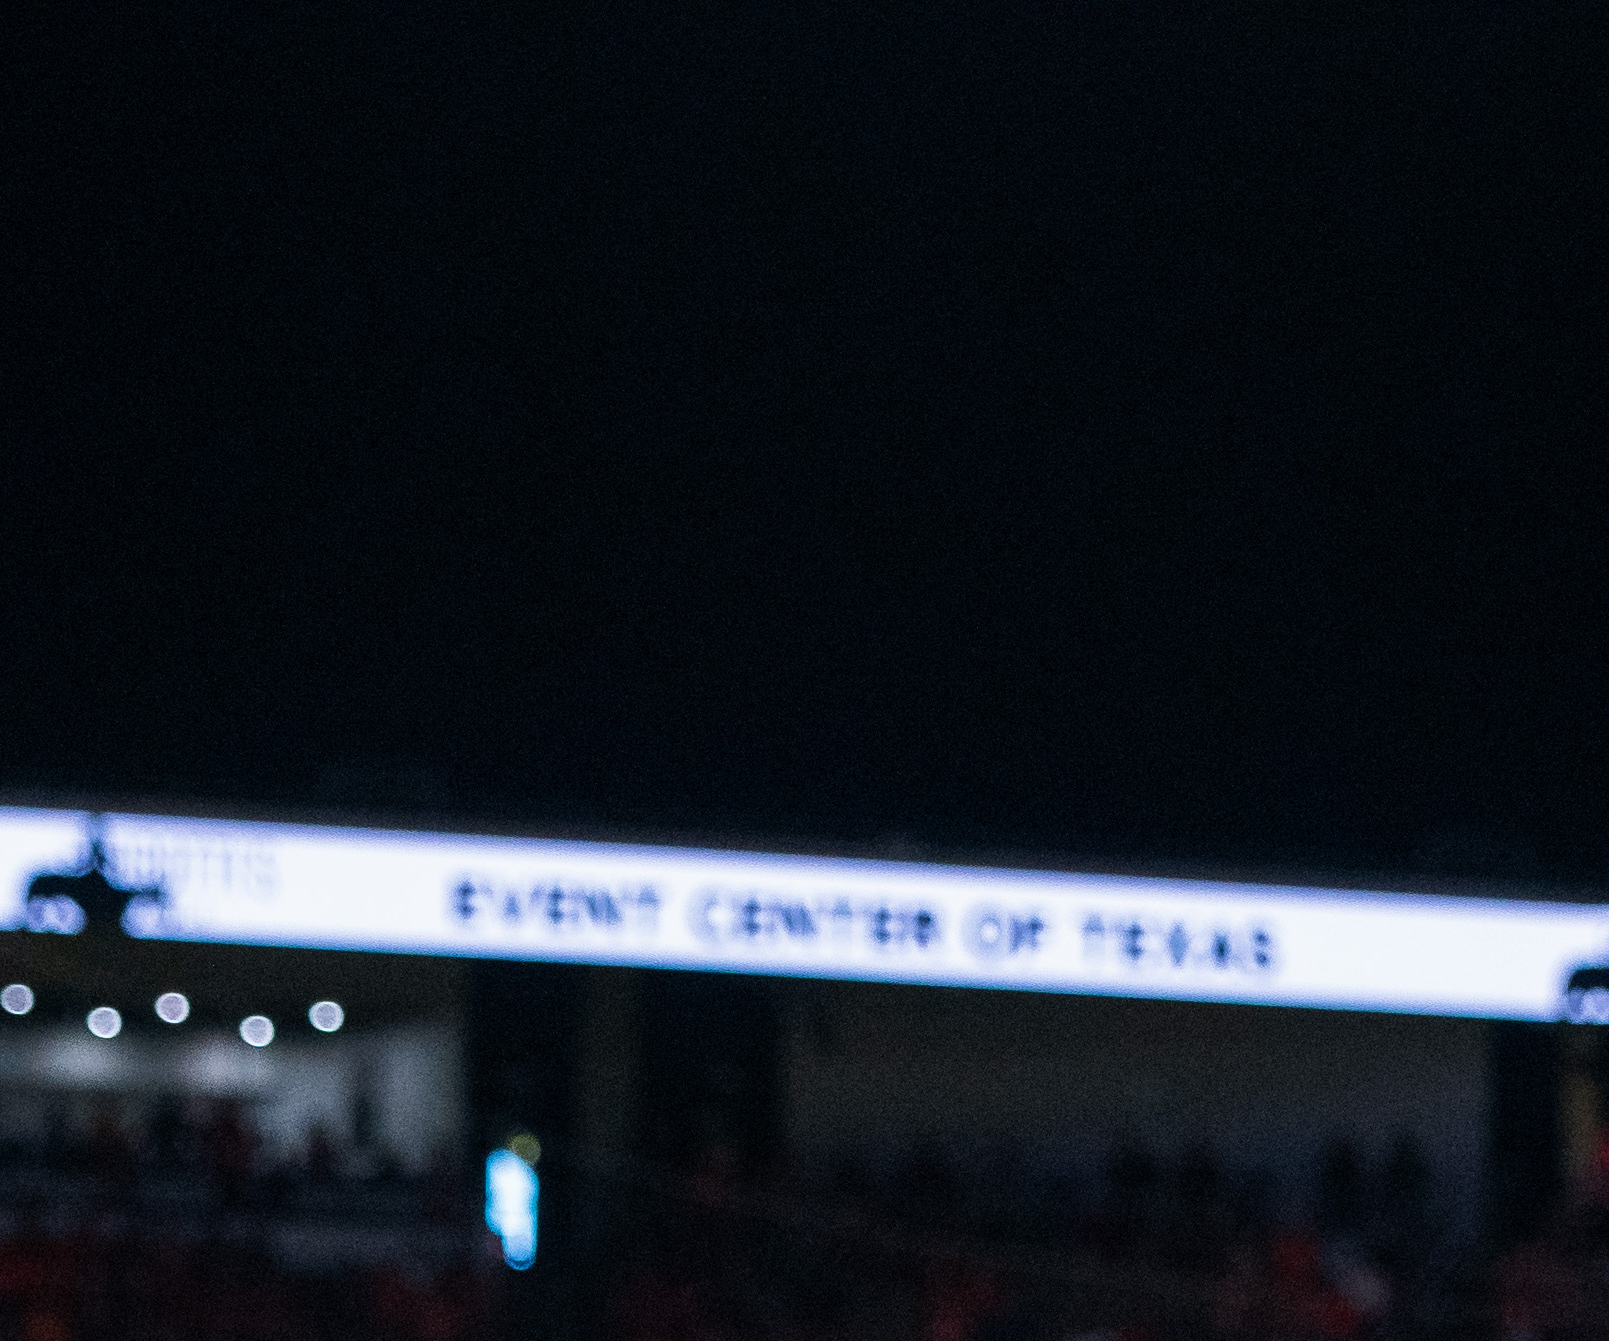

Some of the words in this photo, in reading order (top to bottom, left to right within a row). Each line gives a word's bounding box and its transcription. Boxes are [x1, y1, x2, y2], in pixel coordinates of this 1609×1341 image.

[452, 872, 658, 932] EVENT
[690, 882, 943, 948] CENTER
[960, 898, 1045, 964] OF
[1078, 903, 1283, 975] TEXAS
